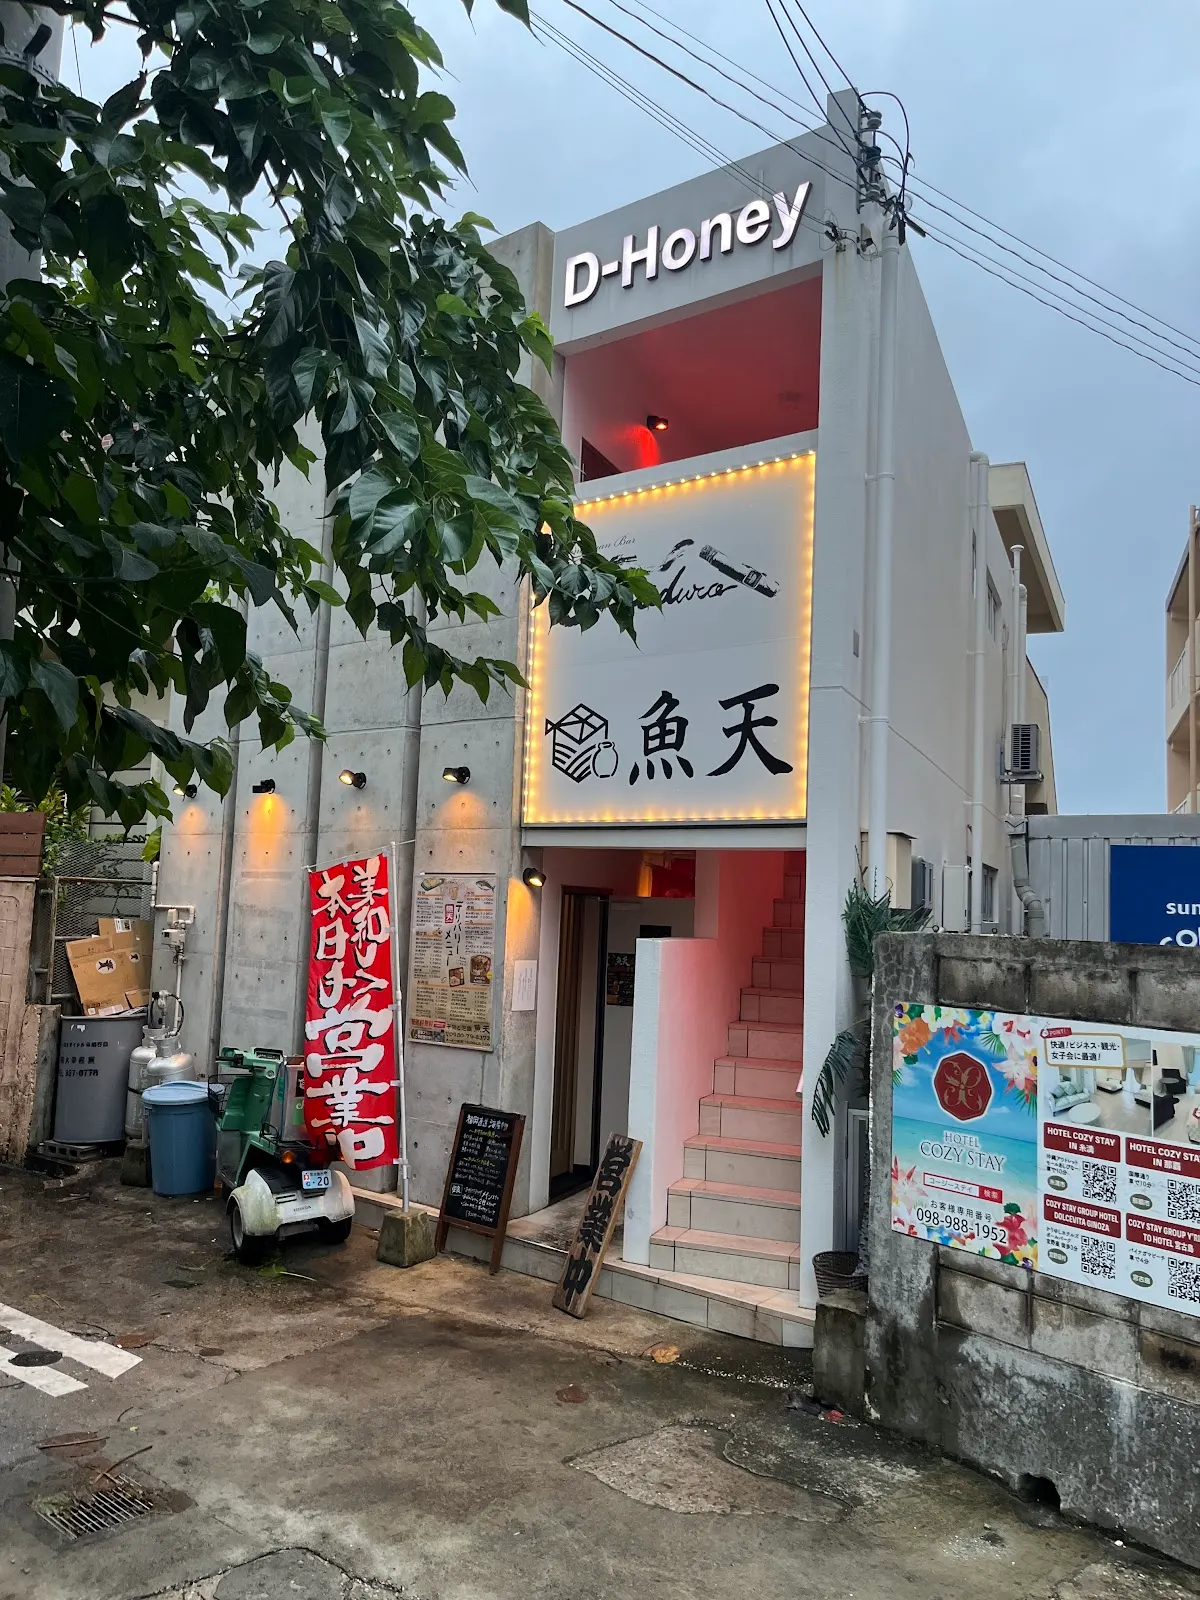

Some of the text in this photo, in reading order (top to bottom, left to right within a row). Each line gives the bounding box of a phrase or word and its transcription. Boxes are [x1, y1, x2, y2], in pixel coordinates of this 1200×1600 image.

[564, 181, 812, 308] D-Honey
[629, 683, 794, 785] 魚天
[945, 1132, 980, 1148] HOTEL
[1047, 1127, 1116, 1146] HOTEL COZY STAY
[1068, 1142, 1077, 1151] IN
[920, 1141, 1005, 1172] COZY STAY
[1129, 1142, 1200, 1163] HOTEL COZY STA
[1152, 1158, 1163, 1167] IN
[1046, 1199, 1119, 1223] COZY STAY GROUP HOTEL
[916, 1207, 1007, 1244] 098-988-1952
[1128, 1218, 1145, 1229] COZY
[1146, 1223, 1163, 1233] STAY
[1163, 1227, 1187, 1239] GROUP
[1143, 1233, 1152, 1242] TO
[1152, 1236, 1174, 1248] HOTEL
